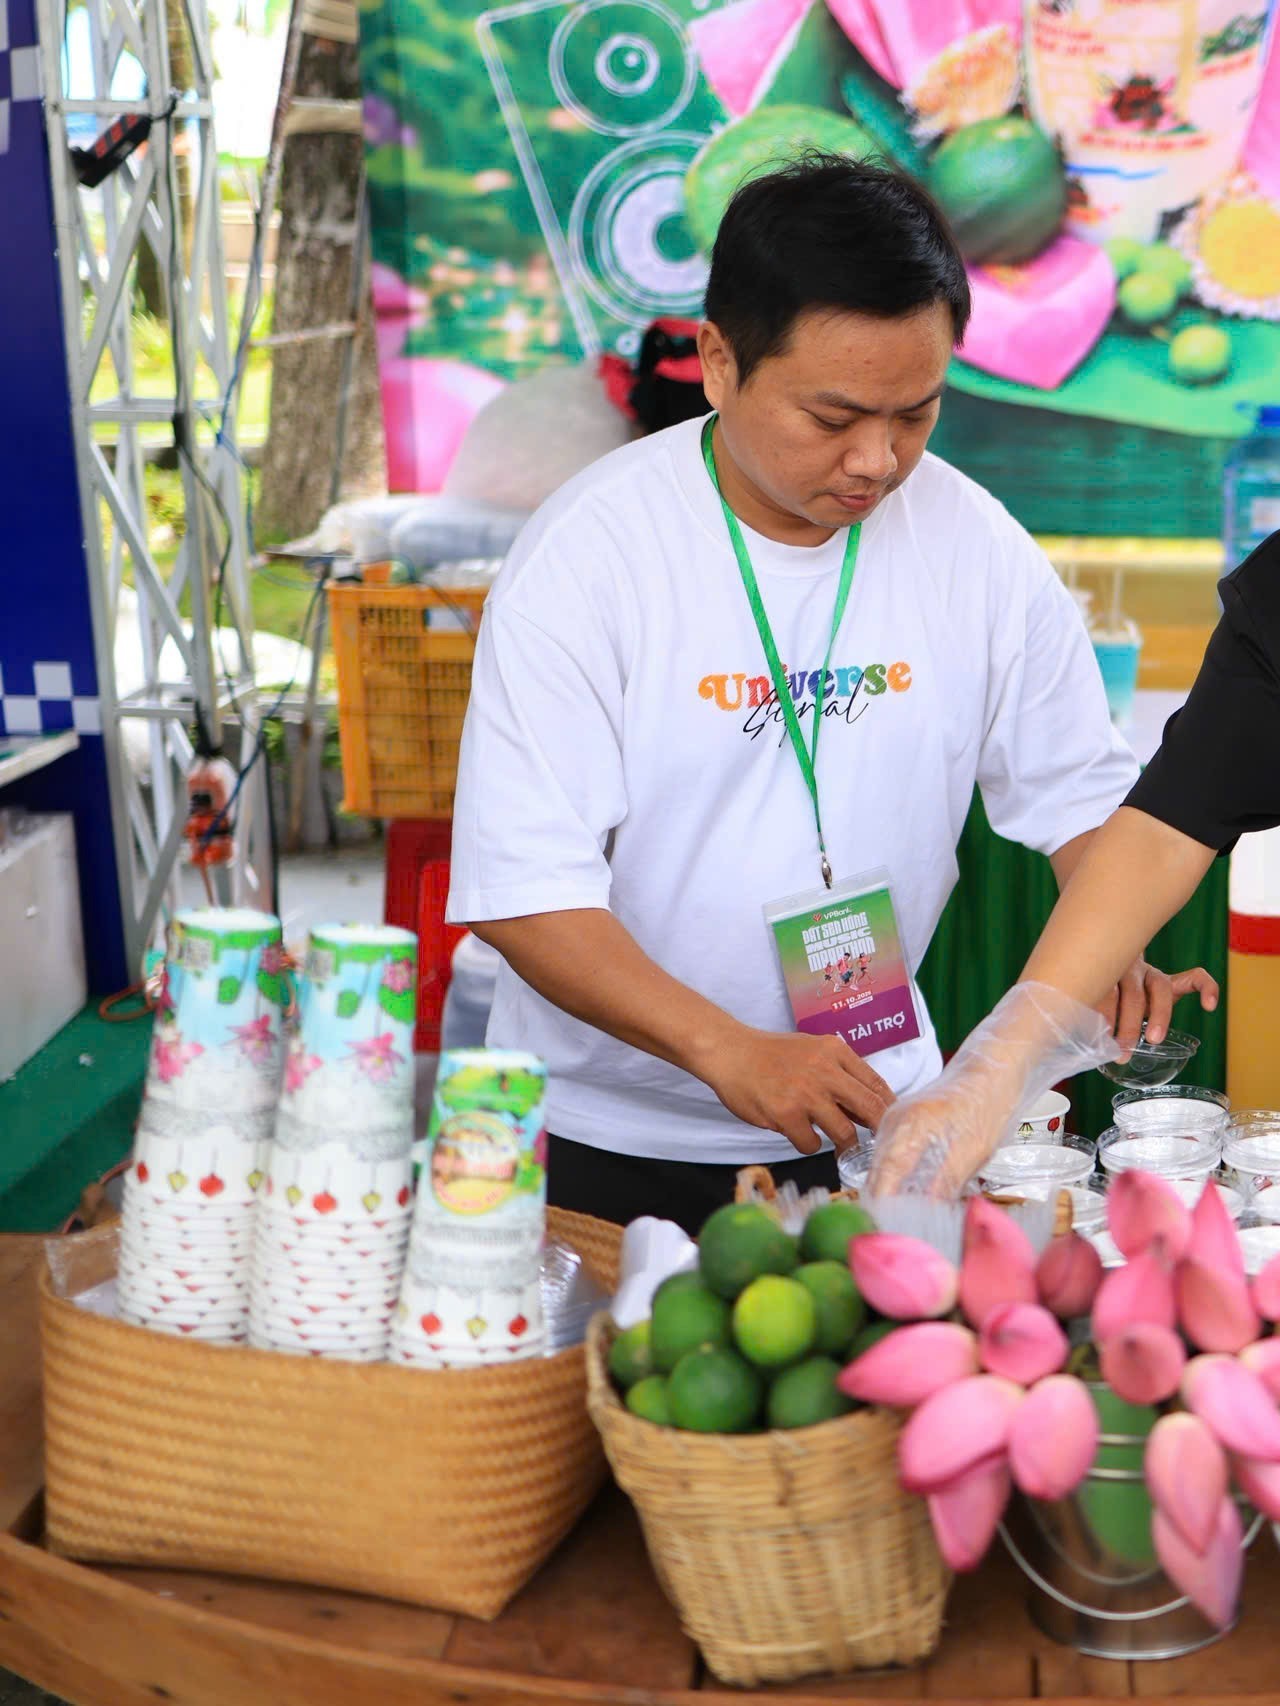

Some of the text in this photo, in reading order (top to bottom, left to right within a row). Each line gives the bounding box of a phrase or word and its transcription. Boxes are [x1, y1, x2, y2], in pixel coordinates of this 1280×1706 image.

[805, 926, 872, 955] MUSIC
[847, 1024, 872, 1041] TÀI
[874, 1011, 905, 1032] TRỢ
